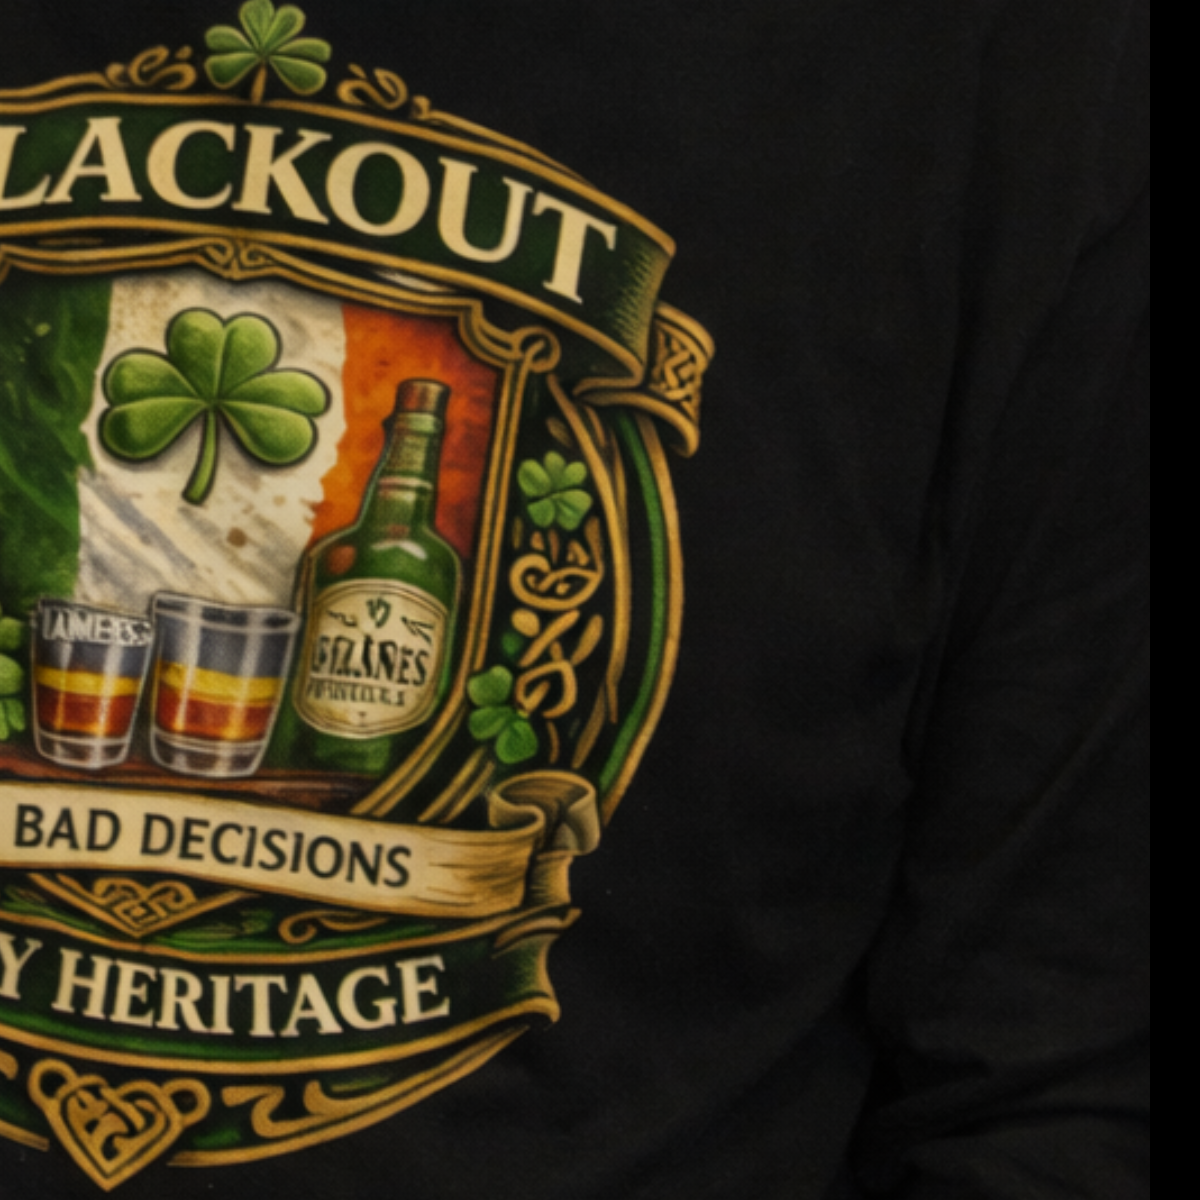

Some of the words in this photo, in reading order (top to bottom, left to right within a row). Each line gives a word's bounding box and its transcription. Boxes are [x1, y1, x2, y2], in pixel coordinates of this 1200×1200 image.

[13, 803, 121, 853] BAD
[139, 812, 413, 889] DECISIONS
[52, 946, 451, 1037] HERITAGE
